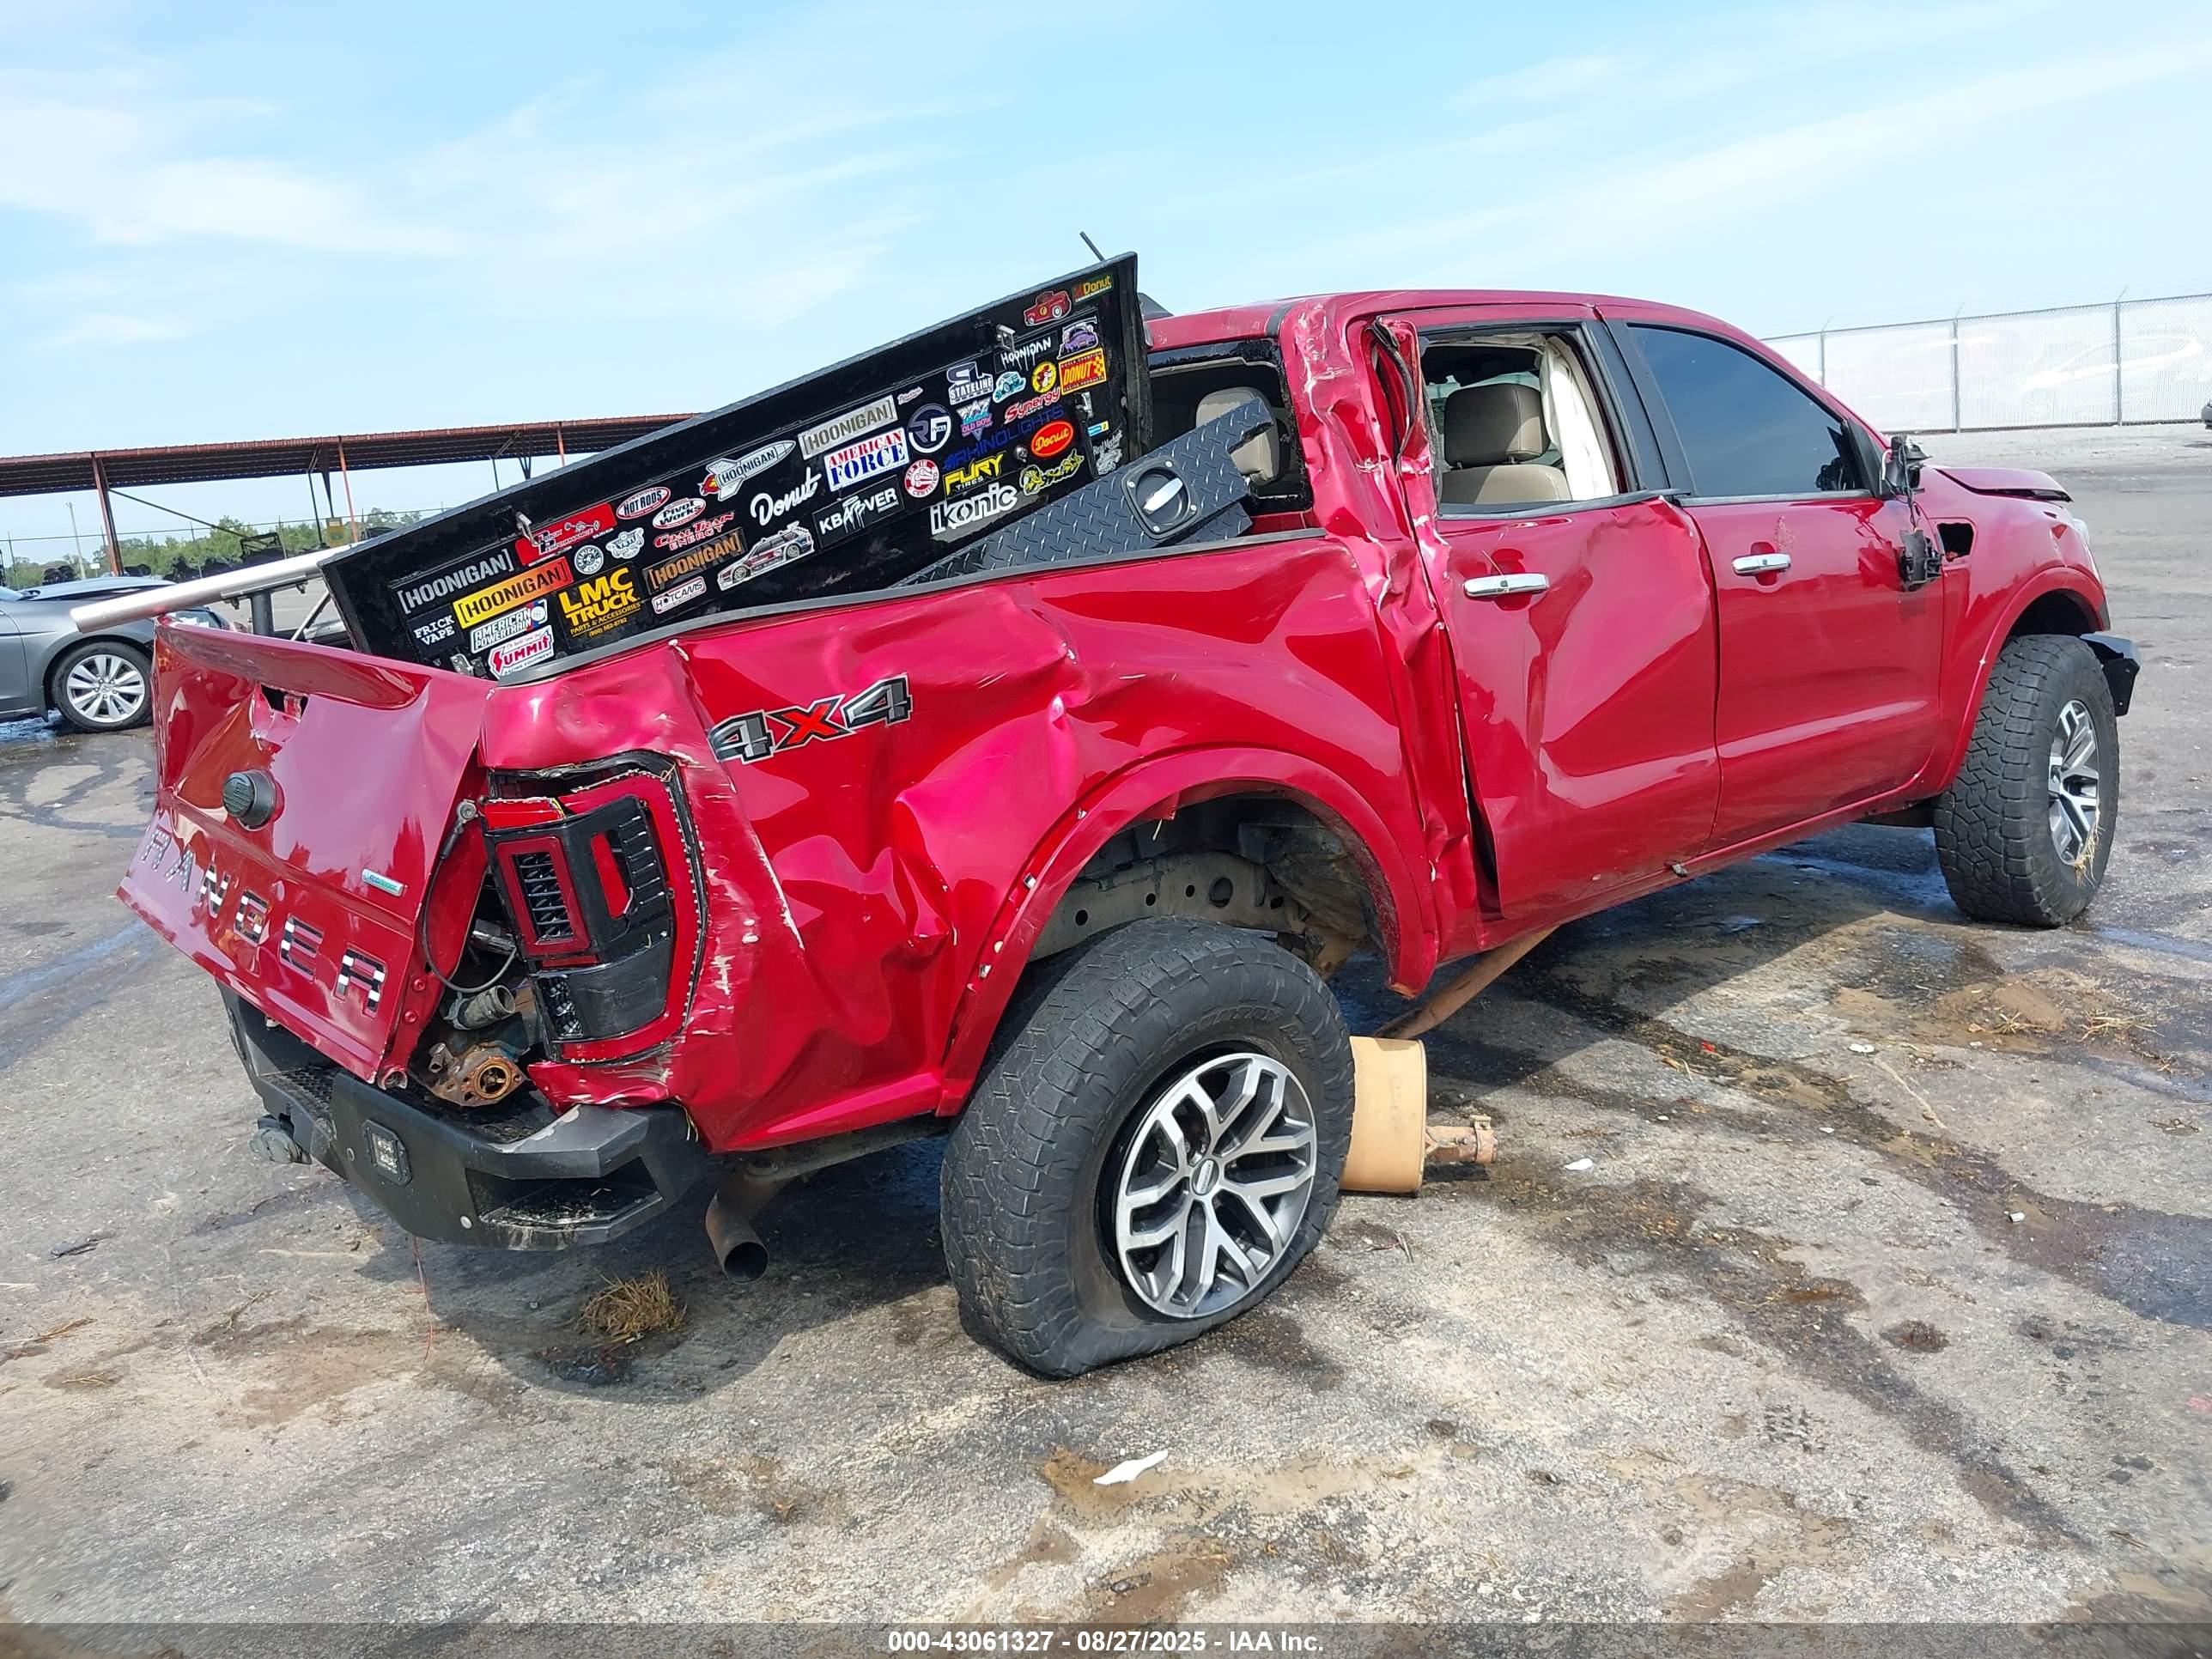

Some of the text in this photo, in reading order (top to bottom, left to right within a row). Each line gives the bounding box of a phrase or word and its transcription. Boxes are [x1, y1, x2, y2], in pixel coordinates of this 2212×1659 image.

[1083, 275, 1112, 295] Donut
[950, 377, 993, 399] STATELINE
[1063, 360, 1093, 386] DONUT
[829, 430, 902, 468] AMERICAN
[1035, 428, 1070, 452] Donut
[830, 442, 906, 486] FORCE
[945, 453, 1004, 496] FURY
[750, 466, 822, 526] Donut
[956, 476, 984, 491] TIRES
[623, 500, 640, 516] HOT
[640, 489, 662, 509] RODS
[558, 567, 633, 614] LMC
[566, 588, 638, 627] TRUCK
[570, 624, 591, 635] PARTS
[599, 603, 641, 624] ACCESSORIES
[413, 615, 456, 640] FRICK
[420, 626, 455, 646] VAPE
[475, 608, 532, 641] AMERICAN
[475, 618, 532, 650] POWERTRAIN
[139, 826, 387, 1019] RANGER
